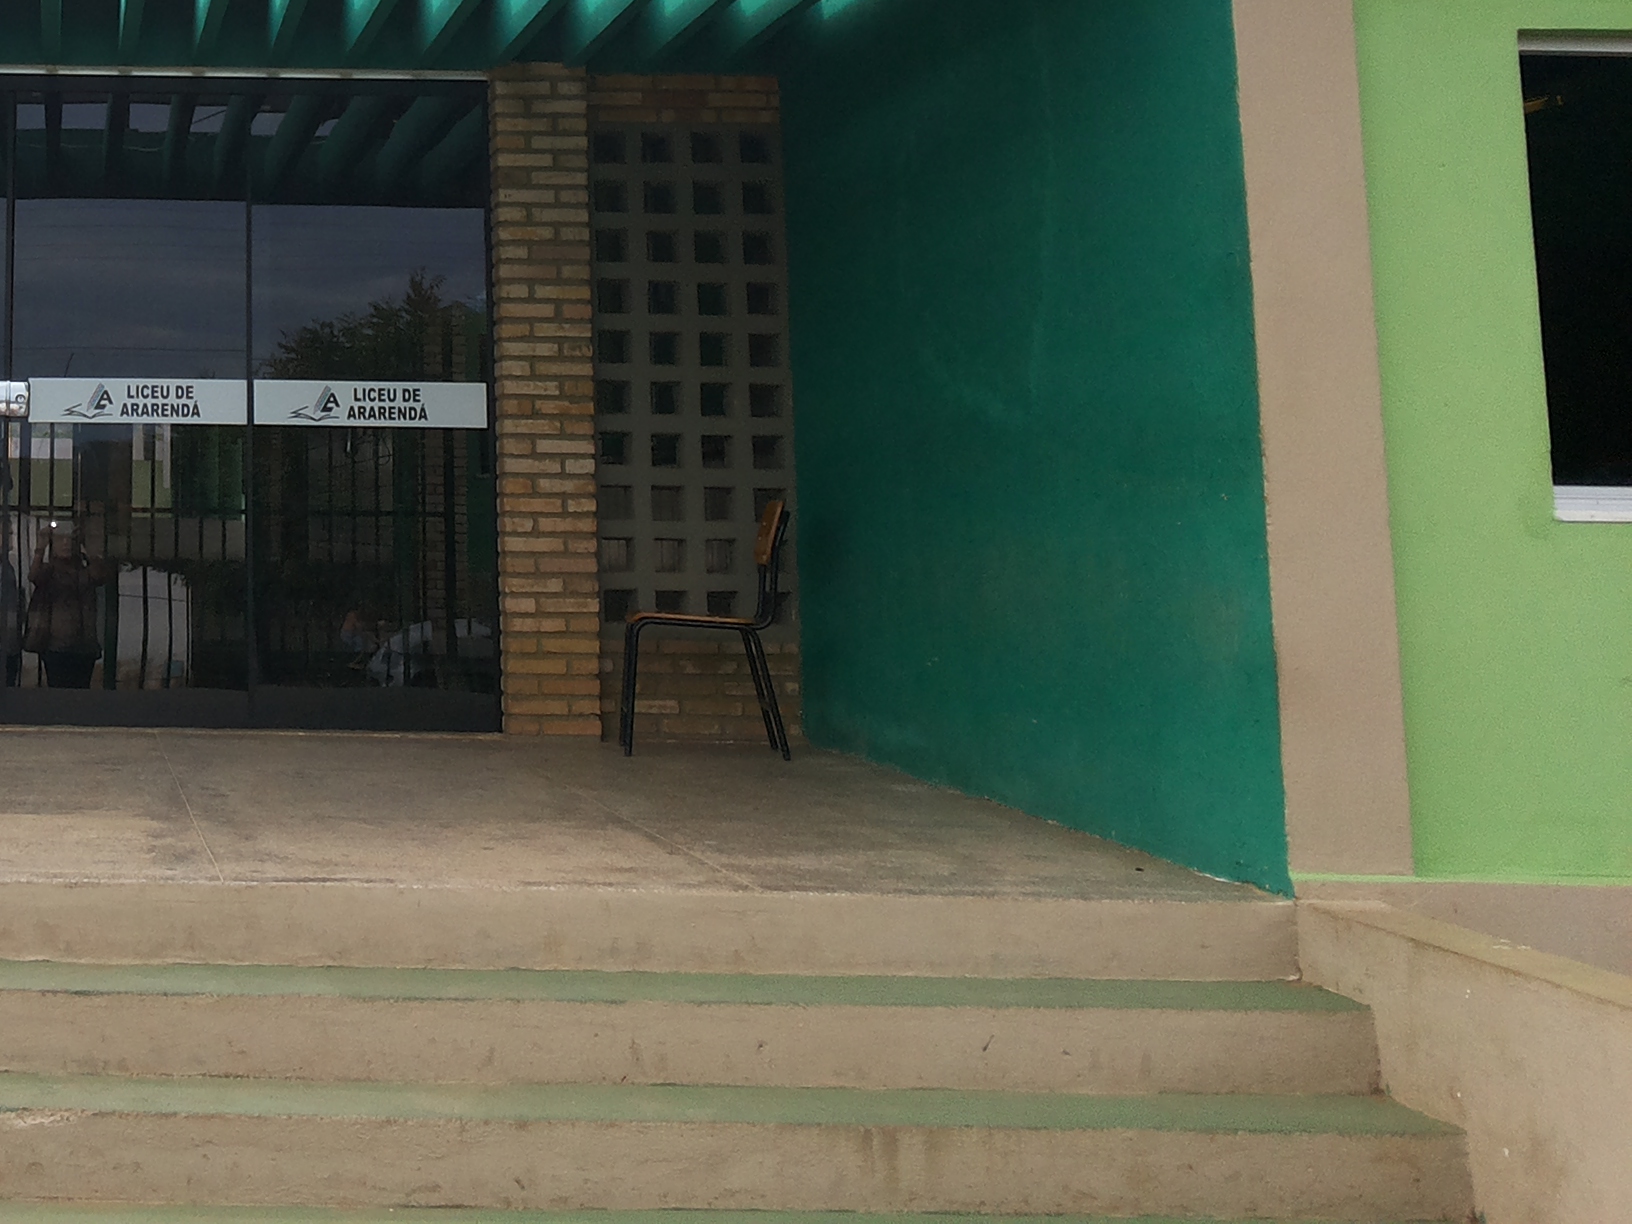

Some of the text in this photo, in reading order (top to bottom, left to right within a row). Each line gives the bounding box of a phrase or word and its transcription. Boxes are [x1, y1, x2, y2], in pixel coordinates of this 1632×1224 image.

[127, 385, 194, 400] LICEU DE
[353, 387, 421, 402] LICEU DE
[120, 399, 201, 418] ARARENDÁ
[346, 402, 428, 421] ARARENDÁ
